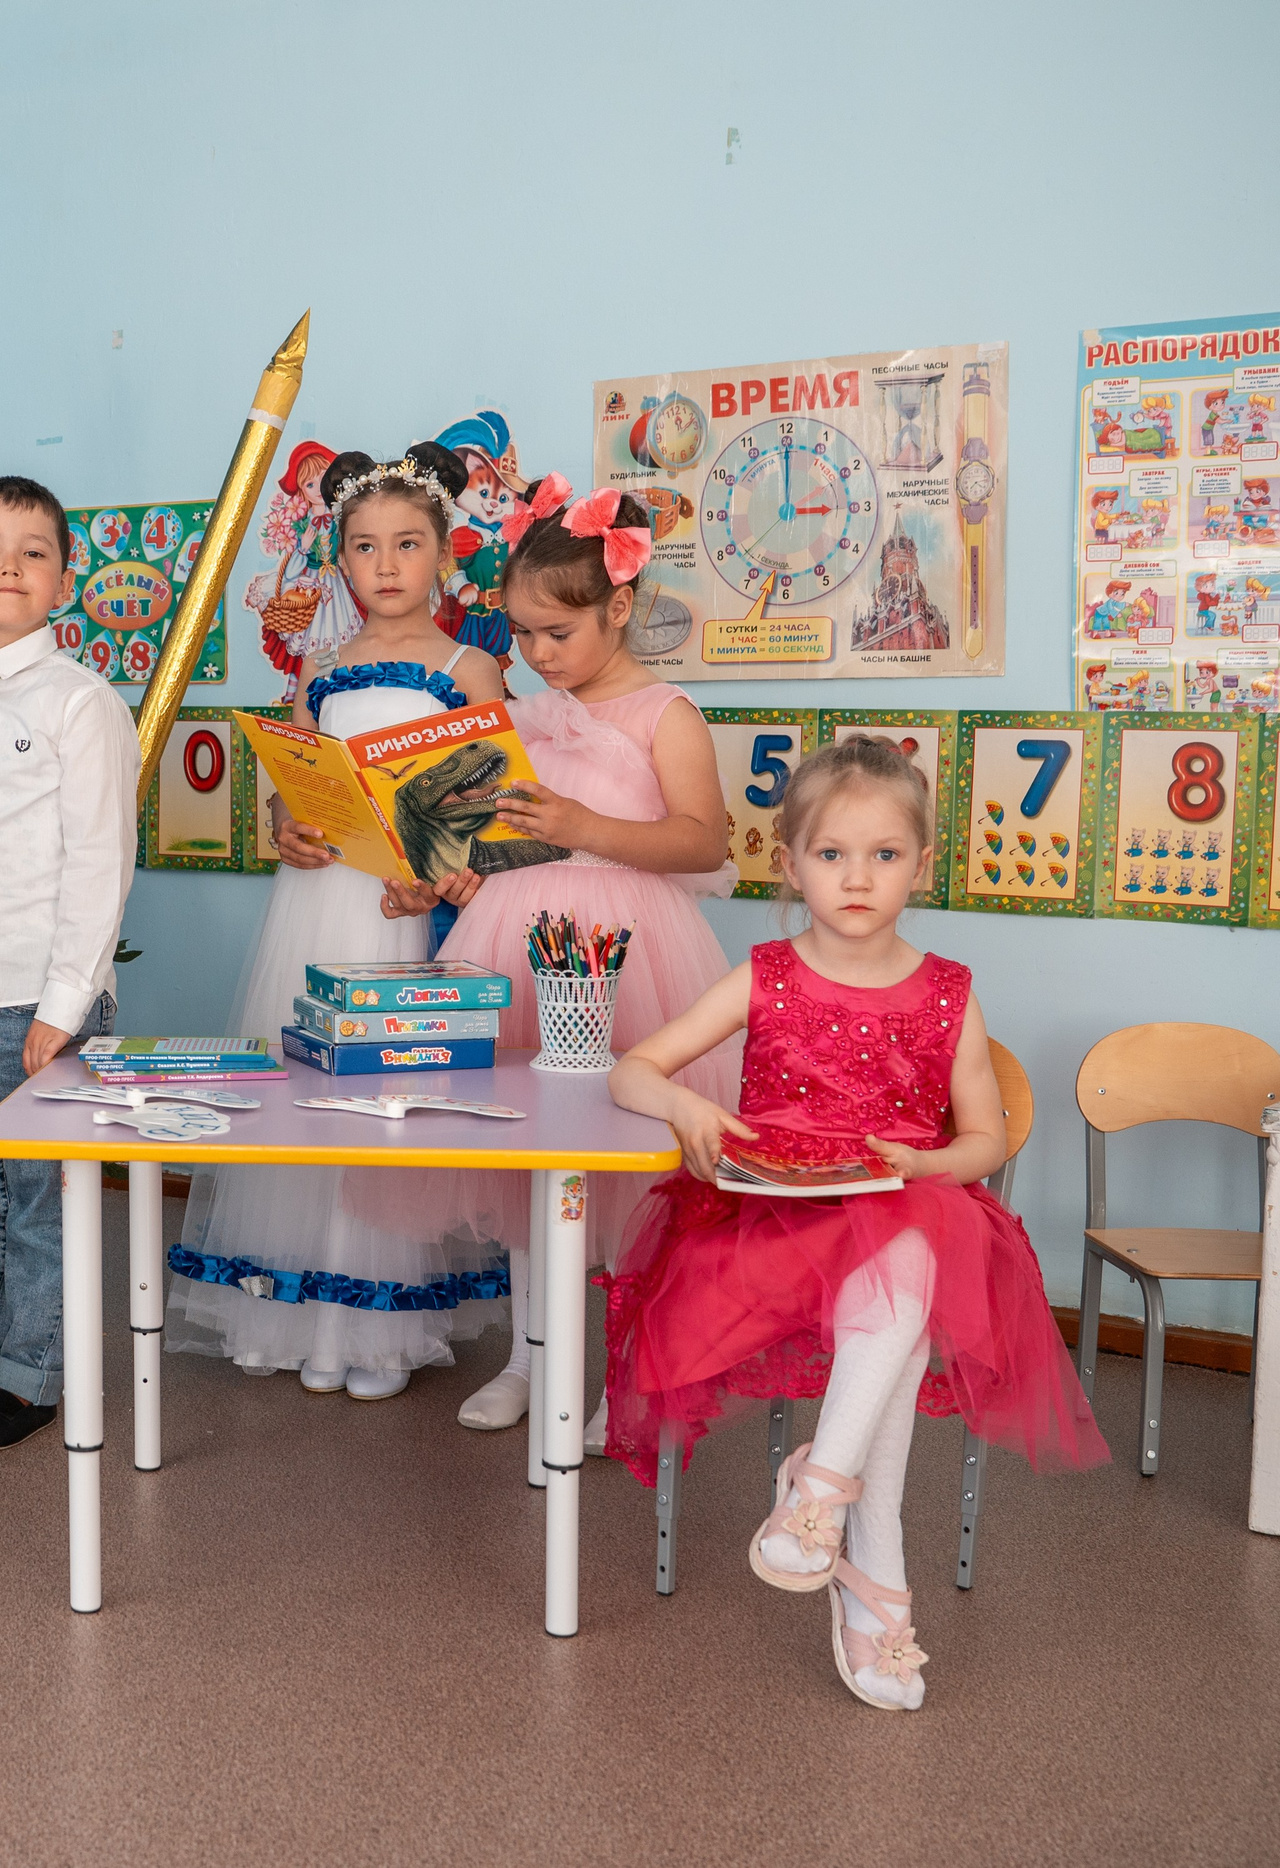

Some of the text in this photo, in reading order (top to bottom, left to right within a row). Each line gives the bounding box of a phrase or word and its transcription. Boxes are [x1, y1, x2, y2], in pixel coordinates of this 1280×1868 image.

[872, 361, 949, 375] ПЕСОЧНЫЕ ЧАСЫ
[711, 370, 860, 418] ВРЕМЯ
[602, 413, 631, 422] ЛИНГ
[779, 423, 794, 434] 12
[823, 431, 829, 441] 1
[741, 437, 753, 447] 11
[750, 459, 776, 480] МИНУТА
[853, 460, 861, 470] 2
[610, 471, 657, 480] БУДИЛЬНИК
[713, 469, 726, 480] 10
[903, 478, 950, 488] НАРУЧНЫЕ
[886, 488, 950, 499] МЕХАНИЧЕСКИЕ
[864, 501, 872, 511] 3
[707, 511, 714, 521] 9
[101, 516, 121, 548] 3
[145, 515, 168, 549] 4
[654, 543, 696, 552] НАРУЧНЫЕ
[852, 543, 860, 554] 4
[717, 550, 724, 561] 8
[760, 556, 790, 568] СЕКУНДА
[743, 579, 751, 590] 7
[822, 576, 830, 586] 5
[84, 570, 169, 604] ВЕСЁЛЫЙ
[782, 589, 790, 600] 6
[97, 593, 152, 618] СЧЁТ
[726, 626, 758, 634] СУТКИ
[769, 624, 782, 632] 24
[783, 624, 811, 632] ЧАСА
[52, 622, 82, 649] 10
[738, 636, 758, 644] ЧАС
[768, 635, 782, 643] 60
[783, 634, 820, 642] МИНУТ
[717, 647, 757, 655] МИНУТА
[783, 645, 825, 654] СЕКУНД
[91, 641, 111, 673] 9
[130, 641, 151, 671] 8
[900, 655, 932, 663] БАШНЕ
[261, 722, 317, 746] ДИНОЗАВРЫ
[364, 711, 500, 761] ДИНОЗАВРЫ
[745, 734, 792, 808] 5
[1016, 739, 1072, 818] 7
[1167, 741, 1225, 822] 8
